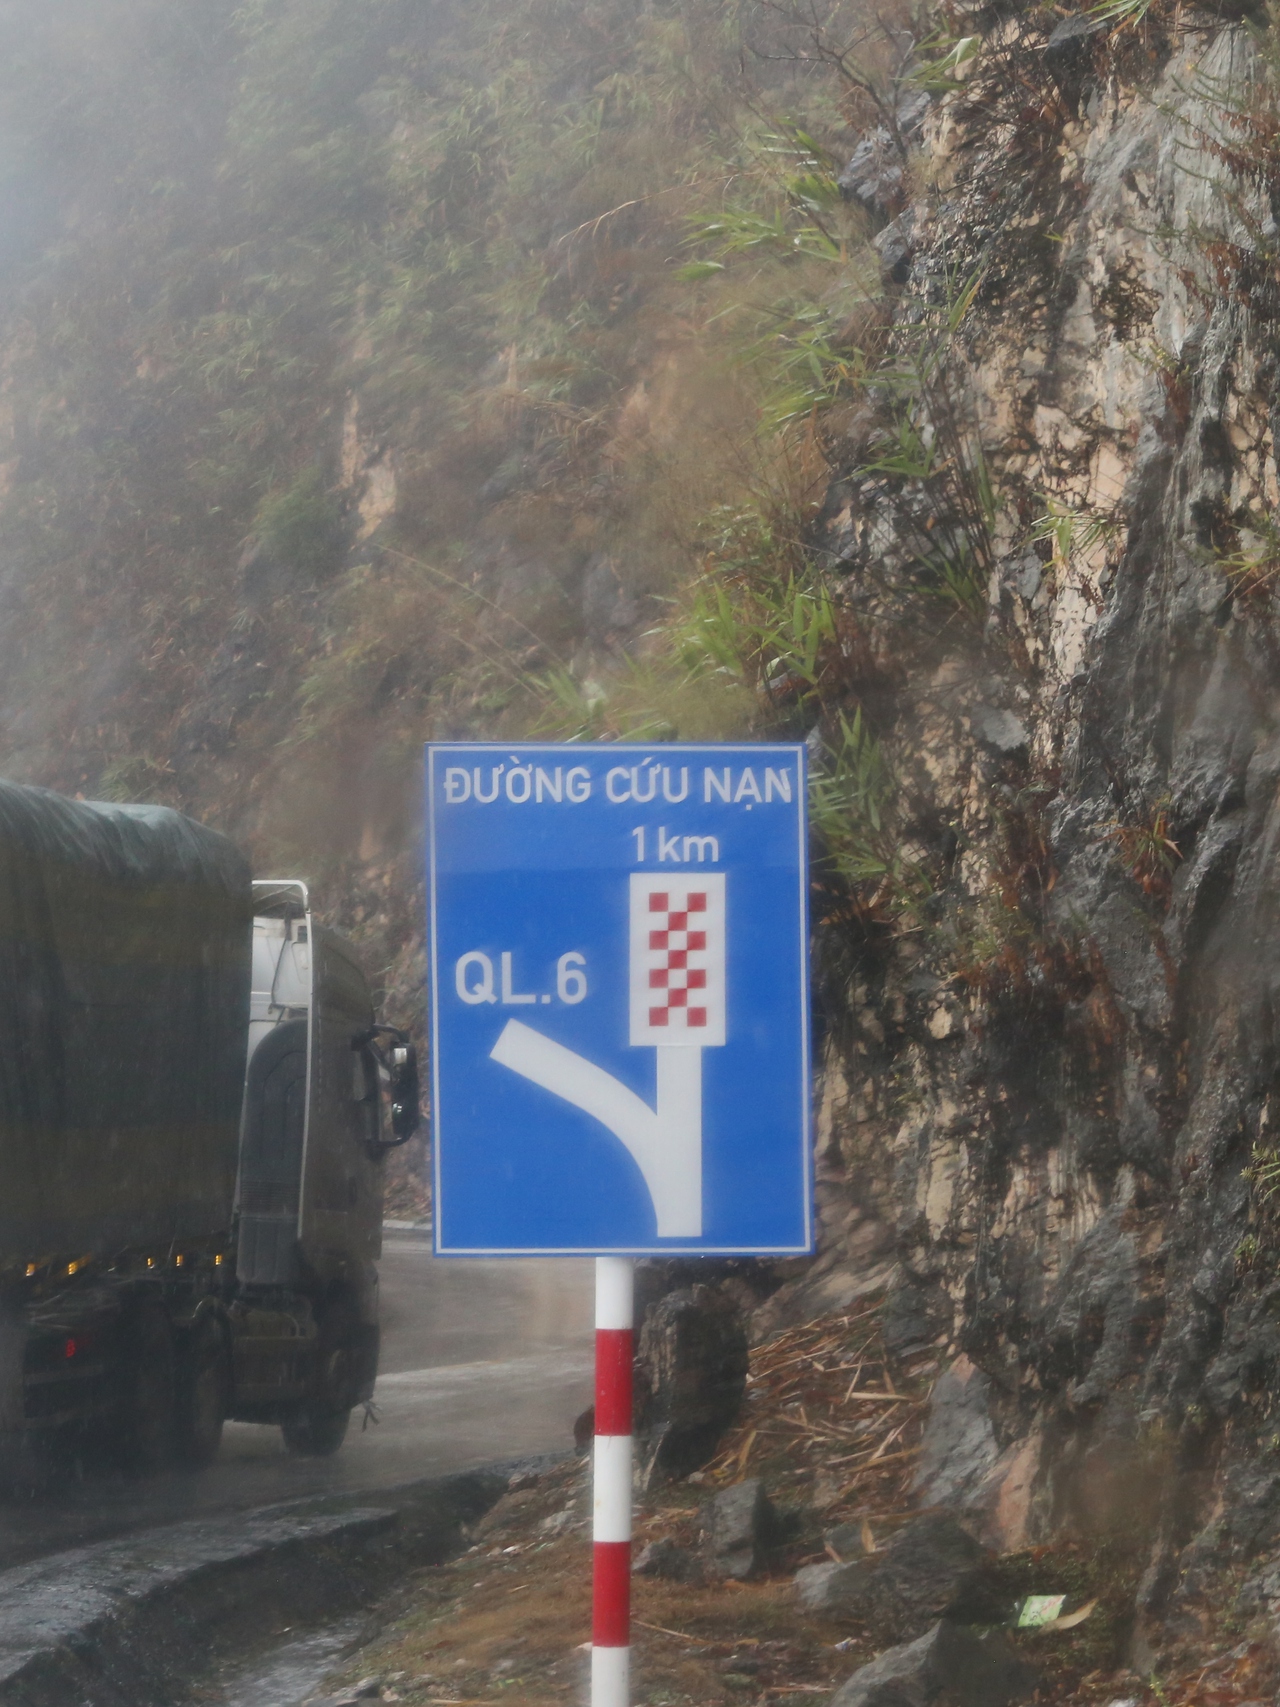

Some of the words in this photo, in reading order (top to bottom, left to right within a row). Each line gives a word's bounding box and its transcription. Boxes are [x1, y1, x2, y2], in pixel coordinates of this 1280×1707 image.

[444, 755, 591, 803] ĐƯỜNG
[606, 757, 688, 802] CỨU
[704, 767, 792, 811] NẠN
[455, 951, 587, 1004] QL.6
